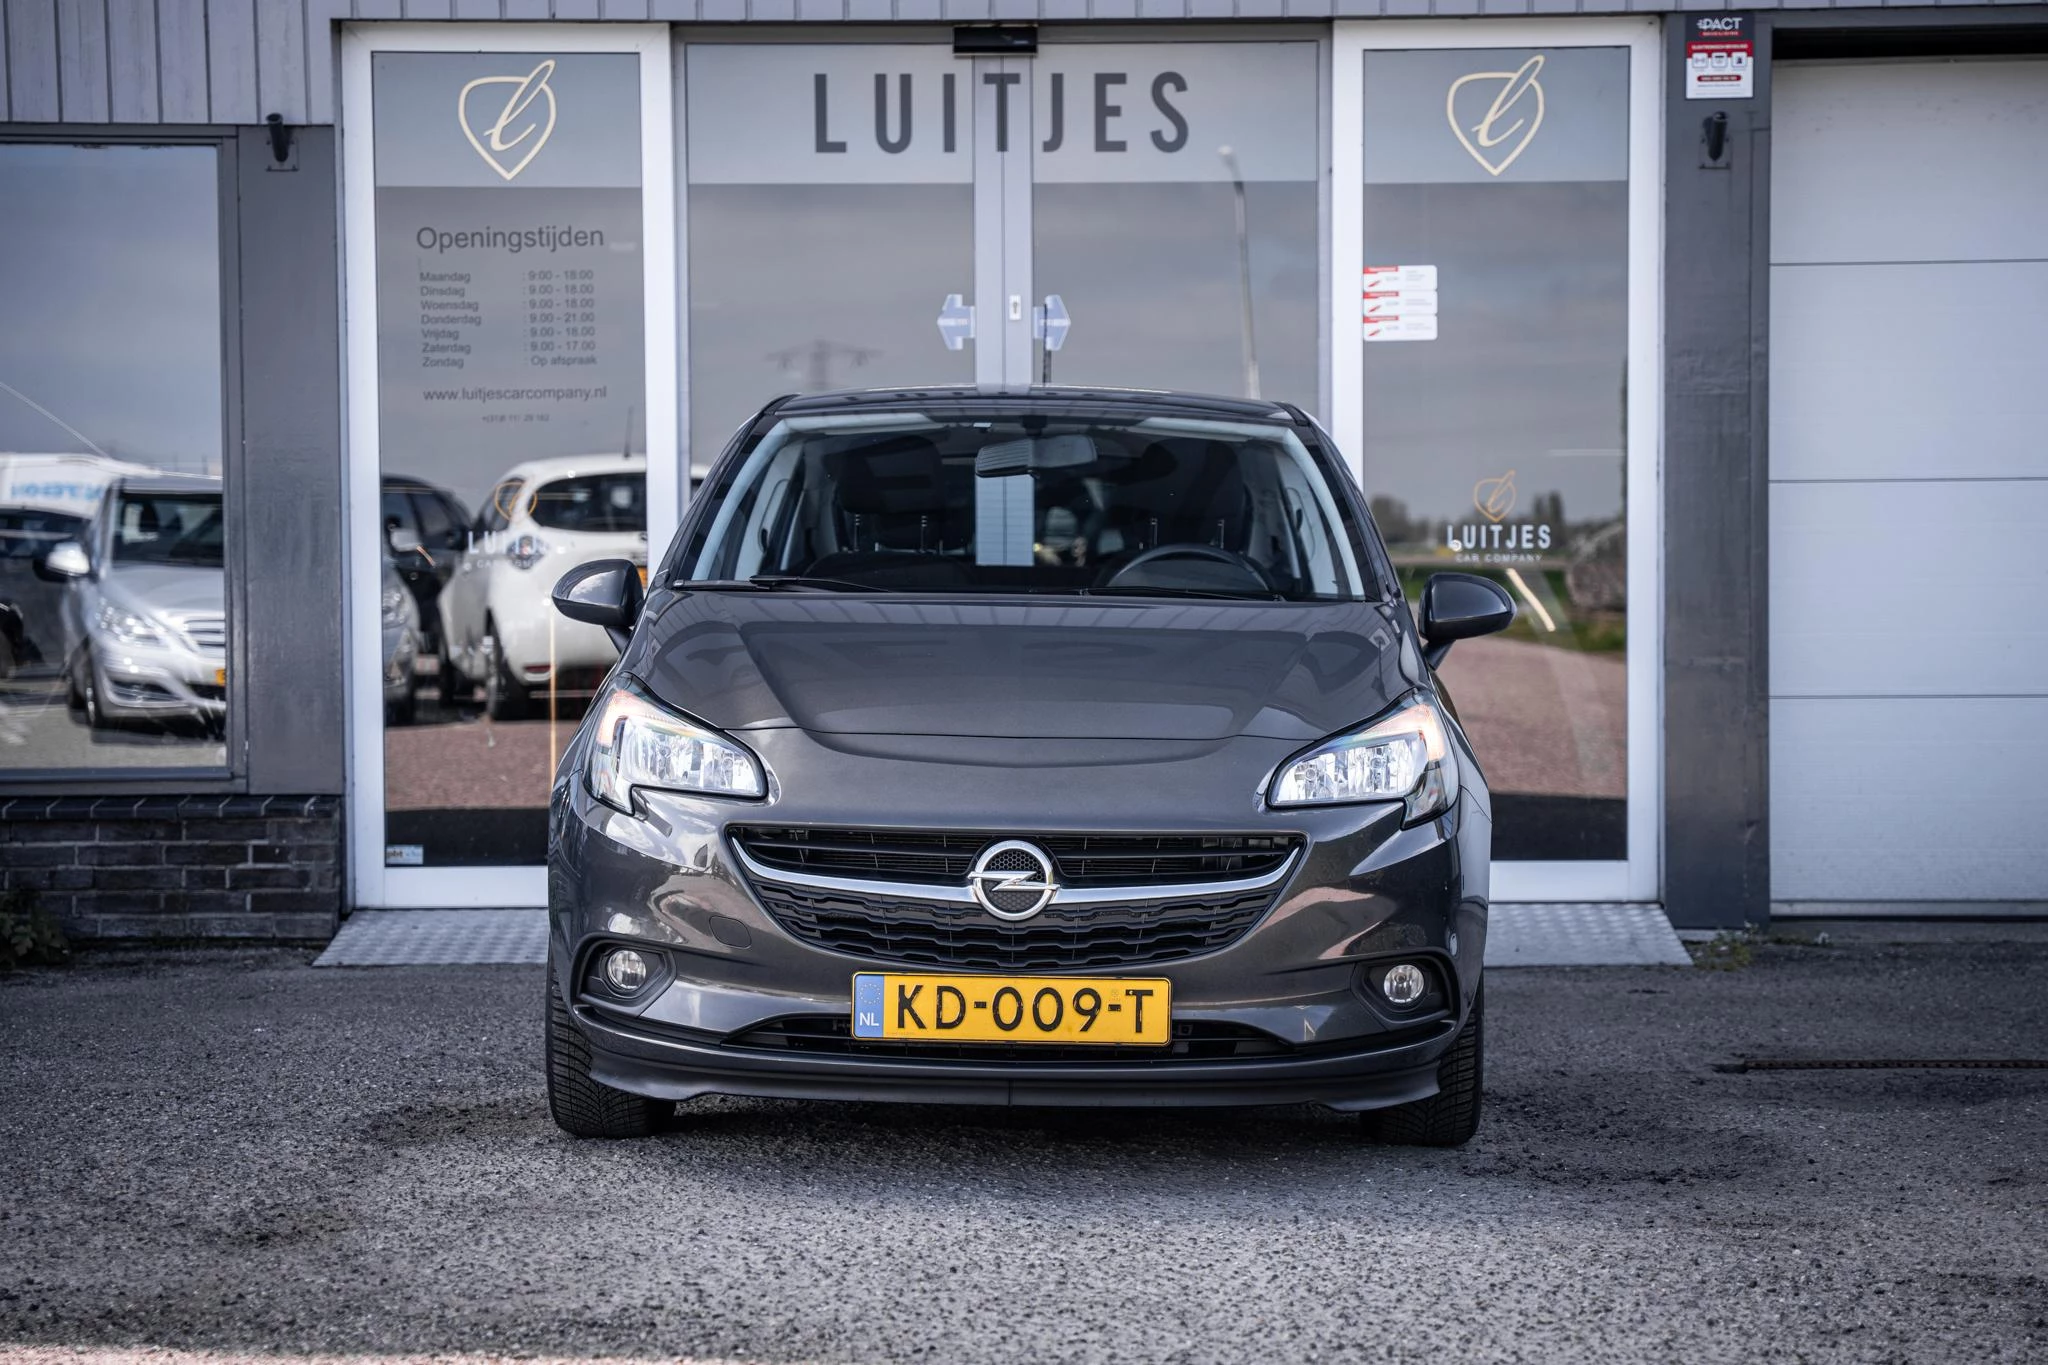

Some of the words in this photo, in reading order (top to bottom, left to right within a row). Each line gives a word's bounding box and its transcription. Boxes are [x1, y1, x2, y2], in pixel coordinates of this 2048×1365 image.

[814, 71, 1189, 154] LUITJES
[416, 225, 605, 254] Openingstijden
[420, 272, 471, 283] Maandag
[421, 286, 465, 297] Dinsdag
[421, 301, 479, 312] Woensdag
[421, 315, 481, 326] Donderdag
[422, 329, 459, 340] Vrijdag
[422, 343, 471, 354] Zaterdag
[423, 357, 464, 369] Zondag
[531, 355, 547, 366] Op
[551, 355, 597, 366] afspraak
[423, 386, 607, 403] www.luitjescarcompany.nl
[1447, 524, 1551, 549] LUITJES
[1456, 553, 1480, 563] CAR
[1484, 553, 1543, 563] COMPANY
[859, 1011, 880, 1027] NL
[897, 984, 1154, 1034] KD-009-T
